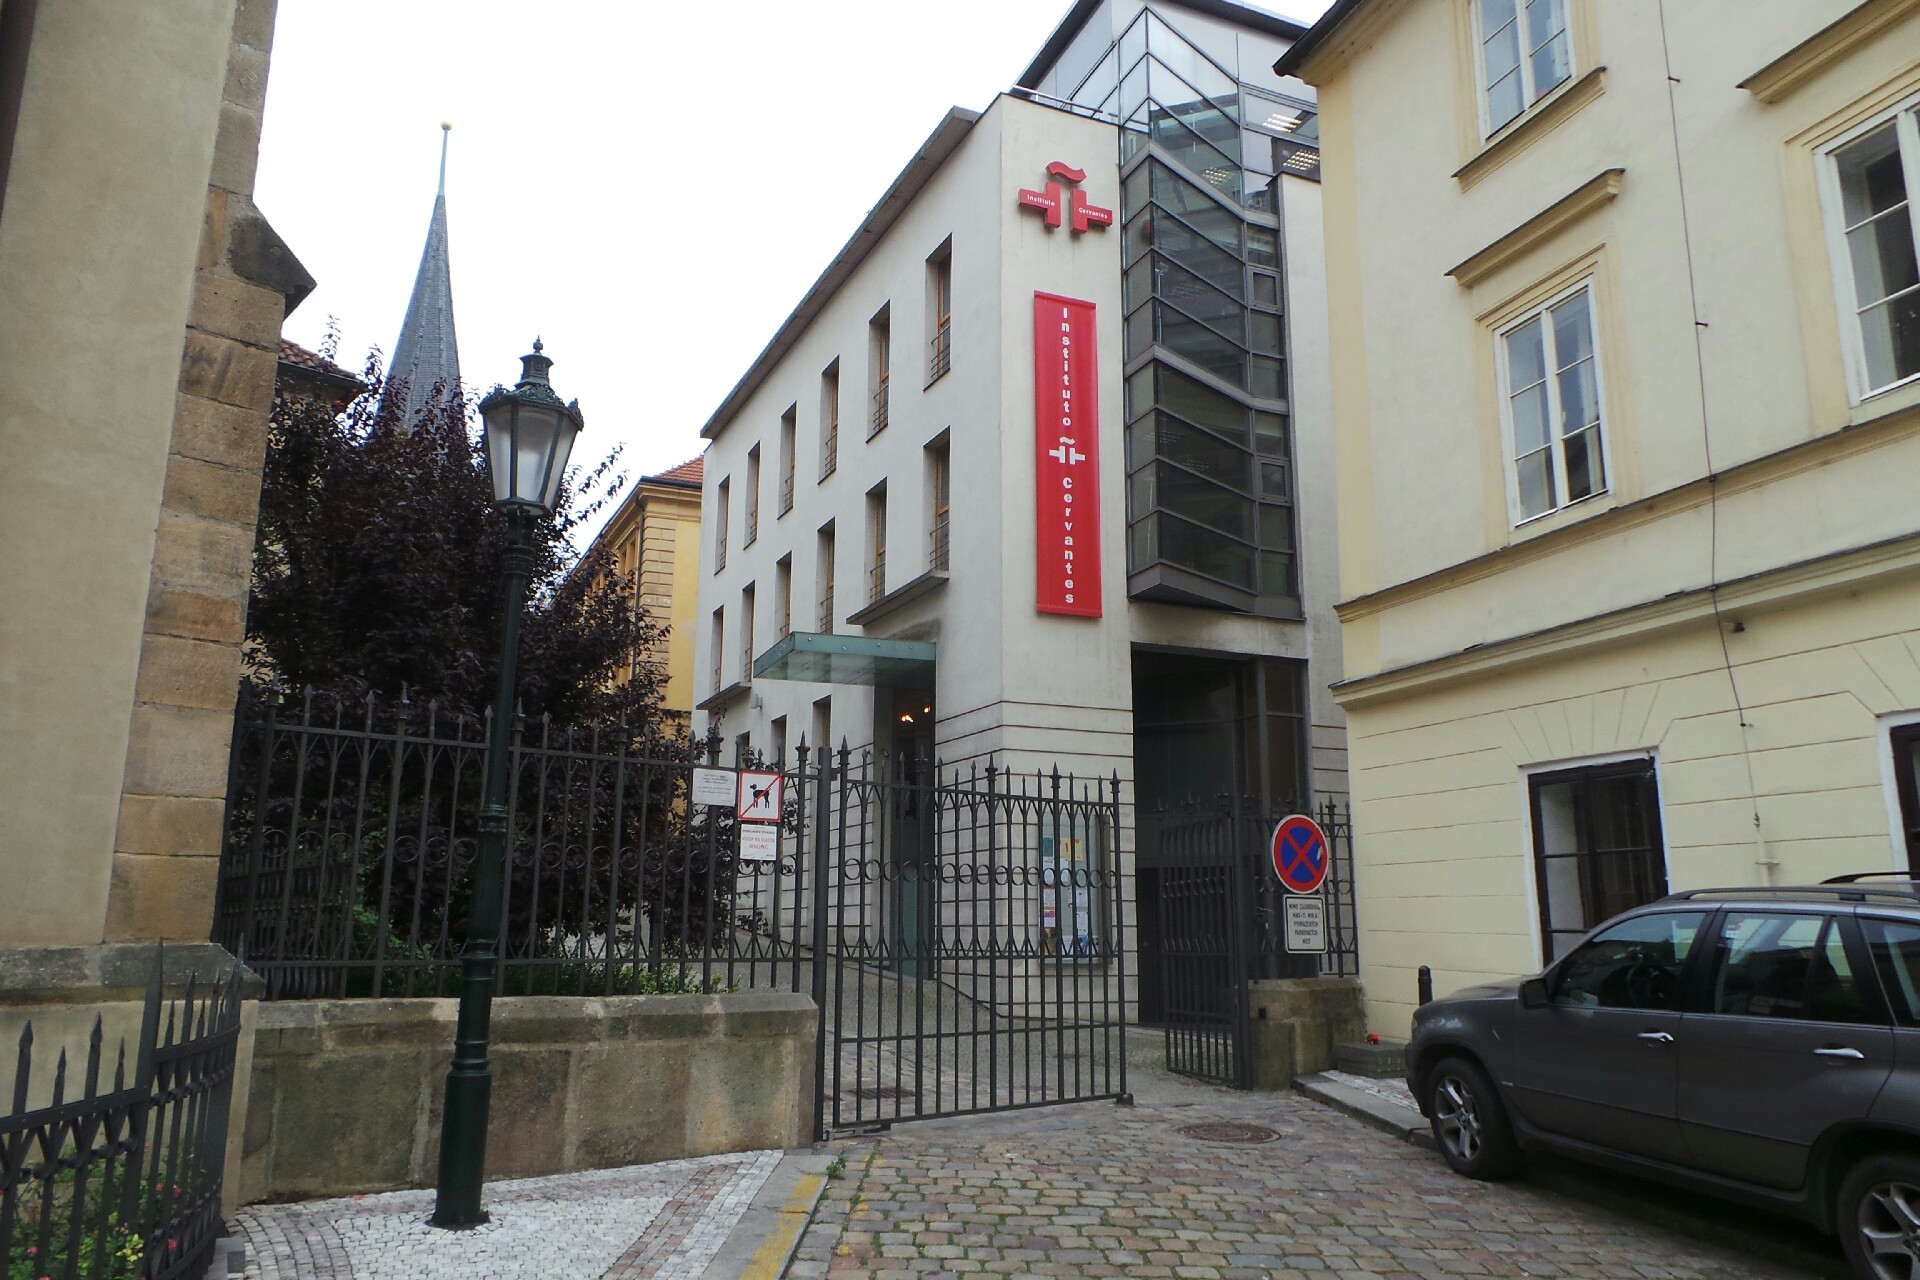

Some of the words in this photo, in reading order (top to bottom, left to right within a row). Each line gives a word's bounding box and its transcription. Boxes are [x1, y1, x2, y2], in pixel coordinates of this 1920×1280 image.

[1027, 194, 1055, 206] Instituto
[1078, 207, 1108, 219] Cervantes
[1061, 307, 1071, 426] Instituto
